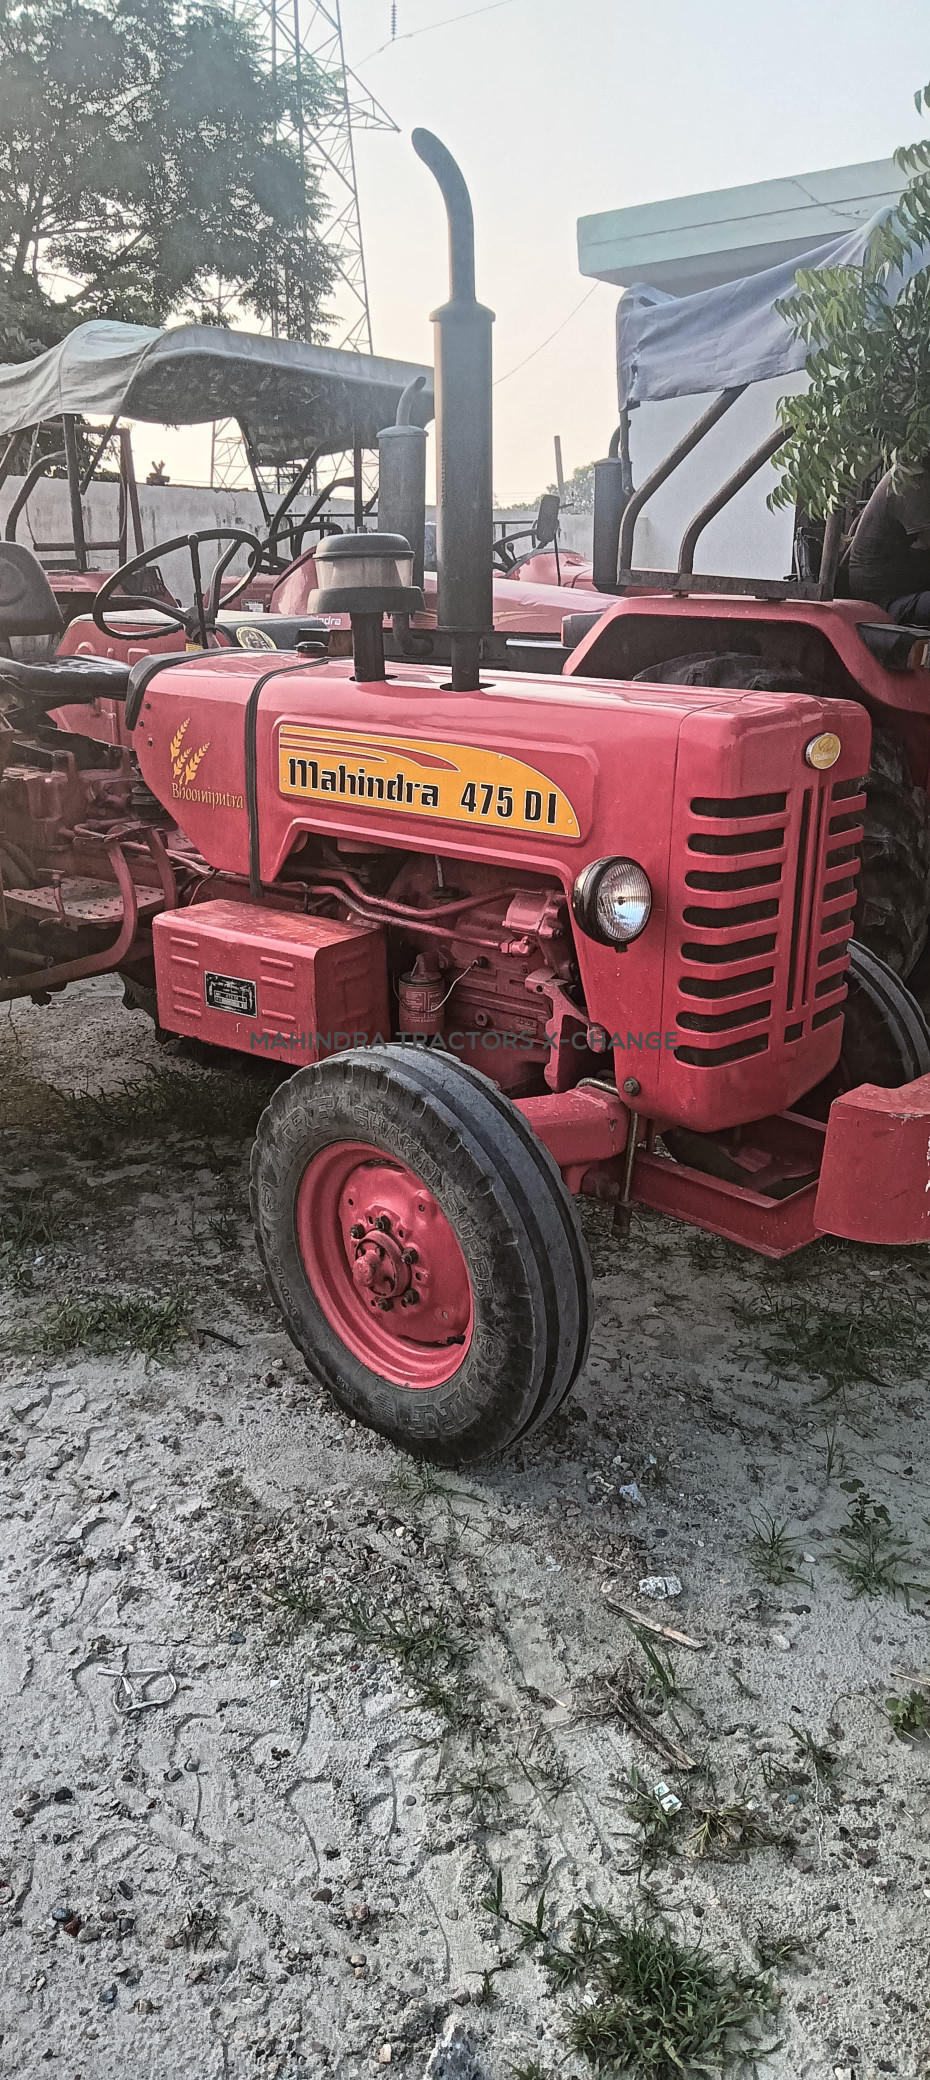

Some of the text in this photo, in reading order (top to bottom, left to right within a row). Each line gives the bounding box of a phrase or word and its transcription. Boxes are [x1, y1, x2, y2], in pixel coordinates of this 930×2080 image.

[171, 782, 244, 811] Bhoomiputra
[288, 757, 559, 825] Mahindra 475 DI
[442, 1188, 494, 1298] SUPER
